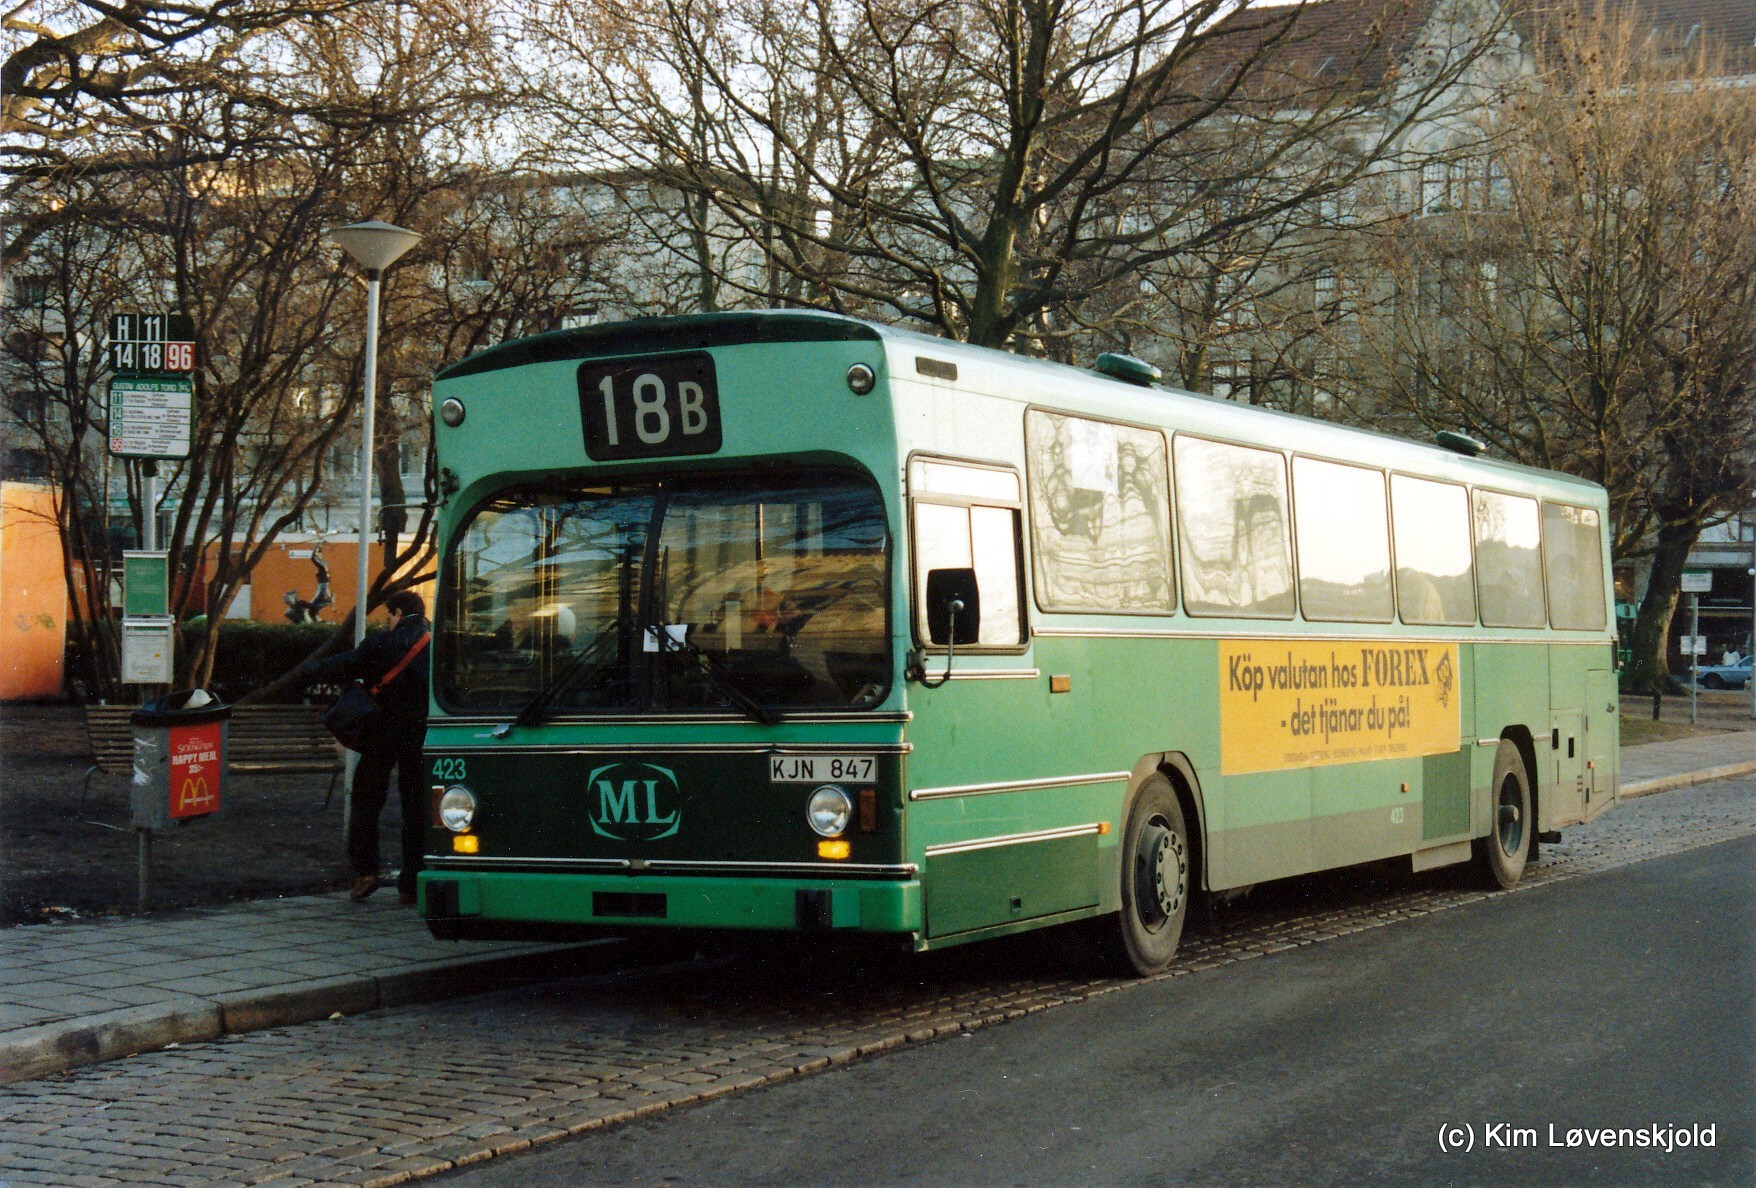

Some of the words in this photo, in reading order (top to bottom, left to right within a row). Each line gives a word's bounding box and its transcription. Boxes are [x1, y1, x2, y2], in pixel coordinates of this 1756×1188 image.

[117, 316, 129, 341] H
[144, 317, 160, 341] 11
[114, 344, 133, 369] 14
[142, 344, 161, 369] 18
[168, 344, 192, 370] 96
[136, 383, 159, 391] ADOLFS
[1229, 653, 1264, 702] Köp
[1267, 652, 1327, 690] valutan
[1331, 652, 1357, 688] hos
[1361, 649, 1430, 688] FOREX
[1291, 697, 1316, 737] det
[1319, 697, 1364, 744] tjänar
[1367, 695, 1384, 730] du
[1388, 695, 1411, 739] på!
[172, 753, 198, 765] HAPPY
[199, 751, 217, 763] MEAL
[432, 758, 466, 780] 423
[772, 760, 815, 780] KJN
[830, 760, 873, 780] 847
[596, 779, 677, 825] ML
